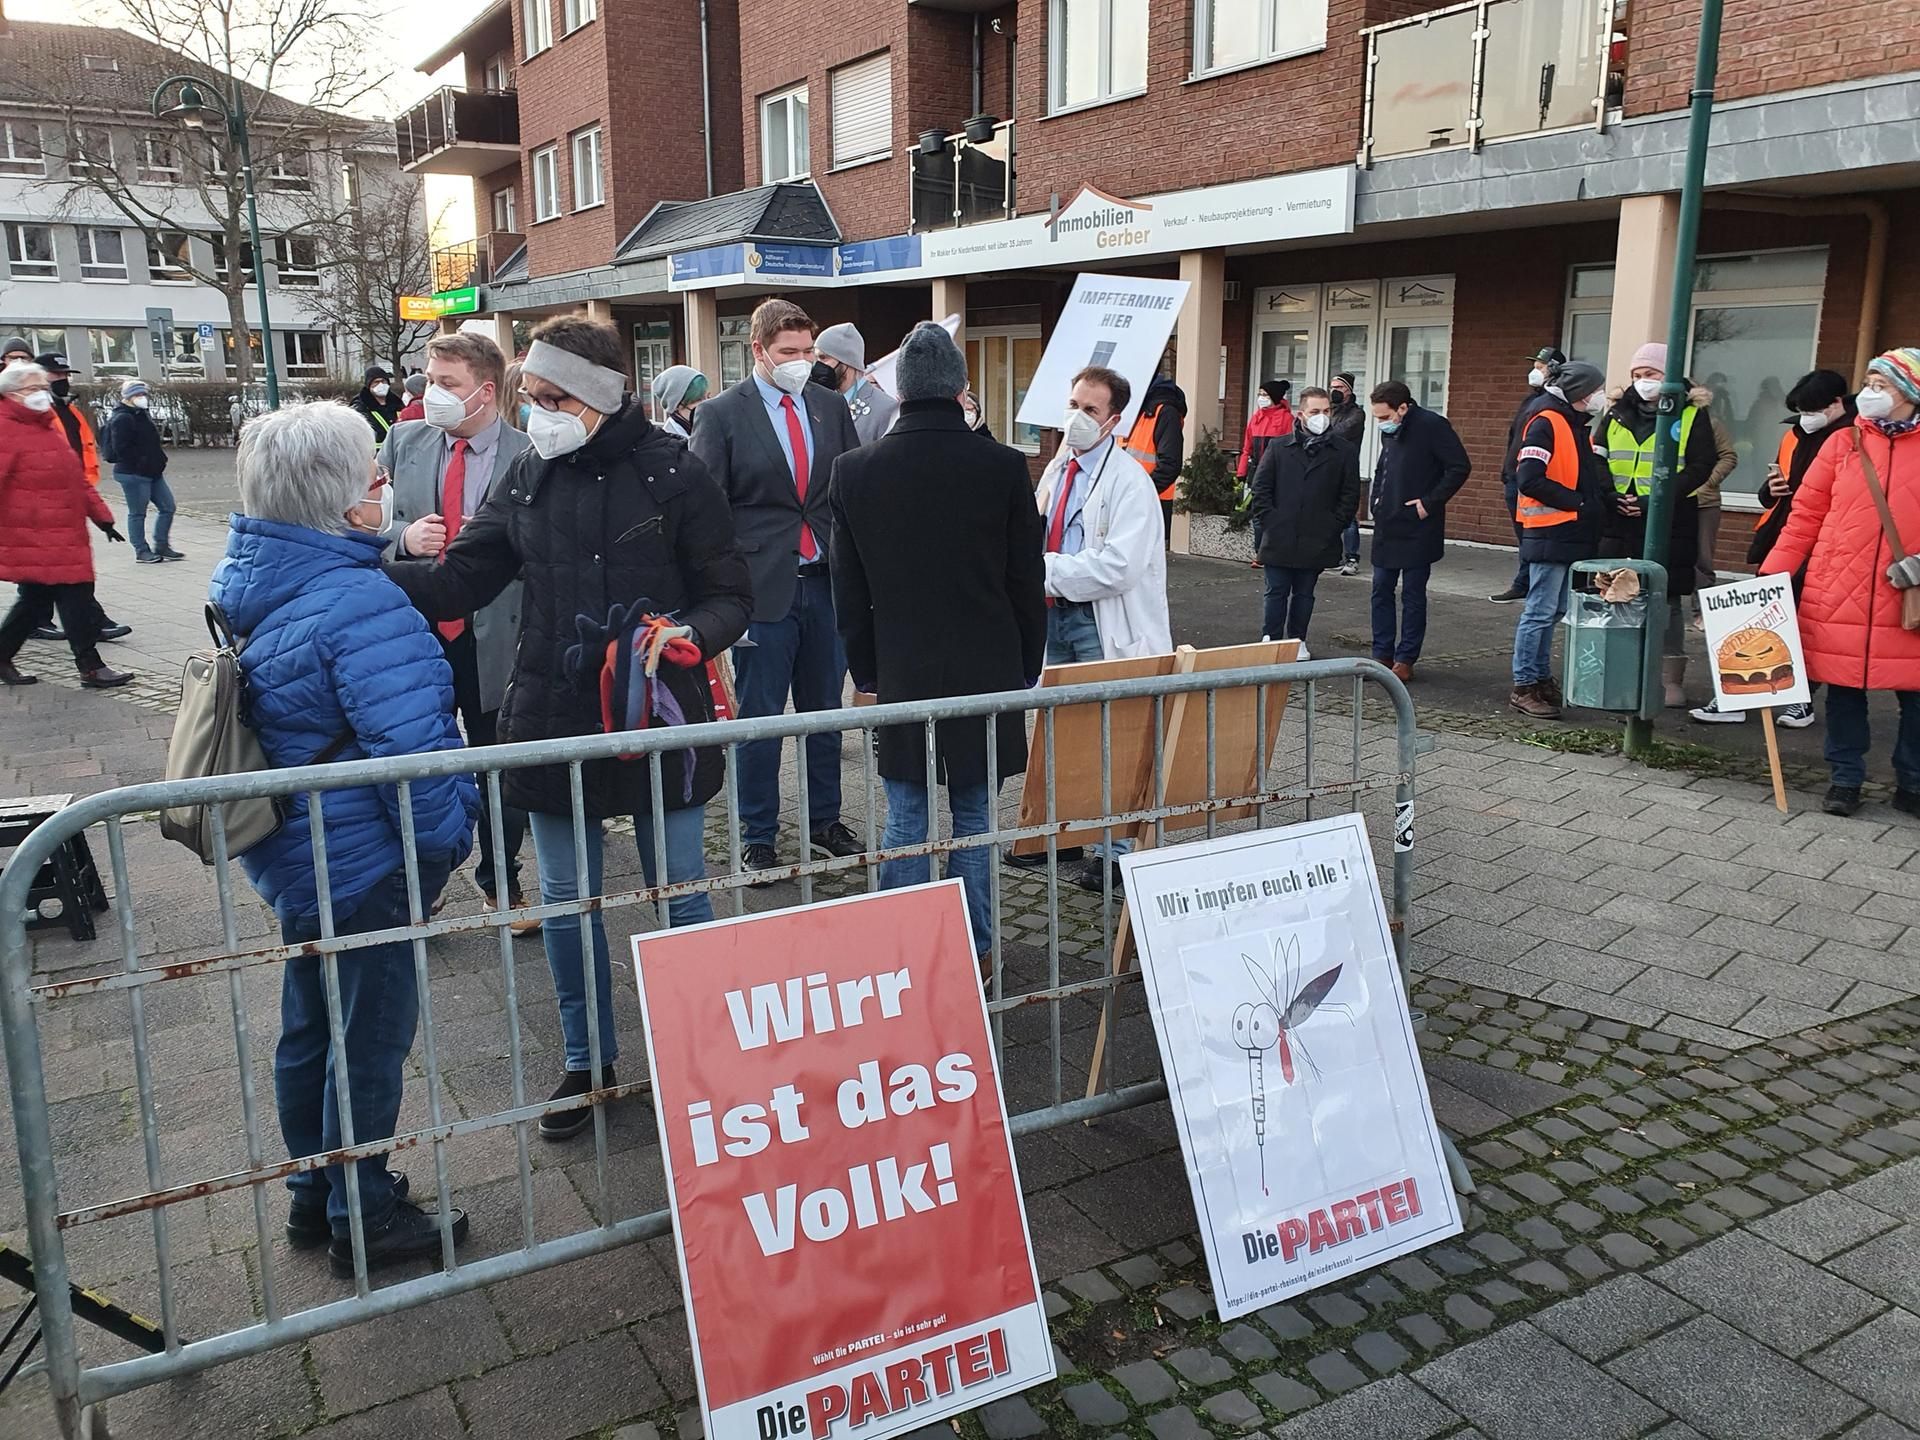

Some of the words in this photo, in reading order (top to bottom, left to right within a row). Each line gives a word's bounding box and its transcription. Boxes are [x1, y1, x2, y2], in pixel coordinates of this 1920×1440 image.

[1163, 216, 1188, 227] Verkauf
[1199, 205, 1273, 223] Neubauprojektierung
[1286, 198, 1332, 211] Vermietung
[1016, 239, 1033, 247] Jahren
[1097, 228, 1151, 248] Gerber
[1079, 290, 1174, 310] IMPFTERMINE
[1100, 313, 1133, 328] HIER
[1156, 891, 1189, 918] Wir
[1195, 882, 1258, 911] impfen
[1262, 870, 1303, 897] euch
[1306, 863, 1337, 888] alle
[724, 967, 912, 1051] Wirr
[687, 1084, 810, 1167] ist
[836, 1052, 978, 1129] das
[741, 1142, 959, 1257] Volk!
[812, 1351, 834, 1366] Wählt
[835, 1346, 848, 1358] Die
[848, 1334, 885, 1353] PARTEI
[893, 1328, 904, 1339] sie
[905, 1324, 915, 1335] ist
[916, 1319, 932, 1331] sehr
[932, 1313, 947, 1328] gut!
